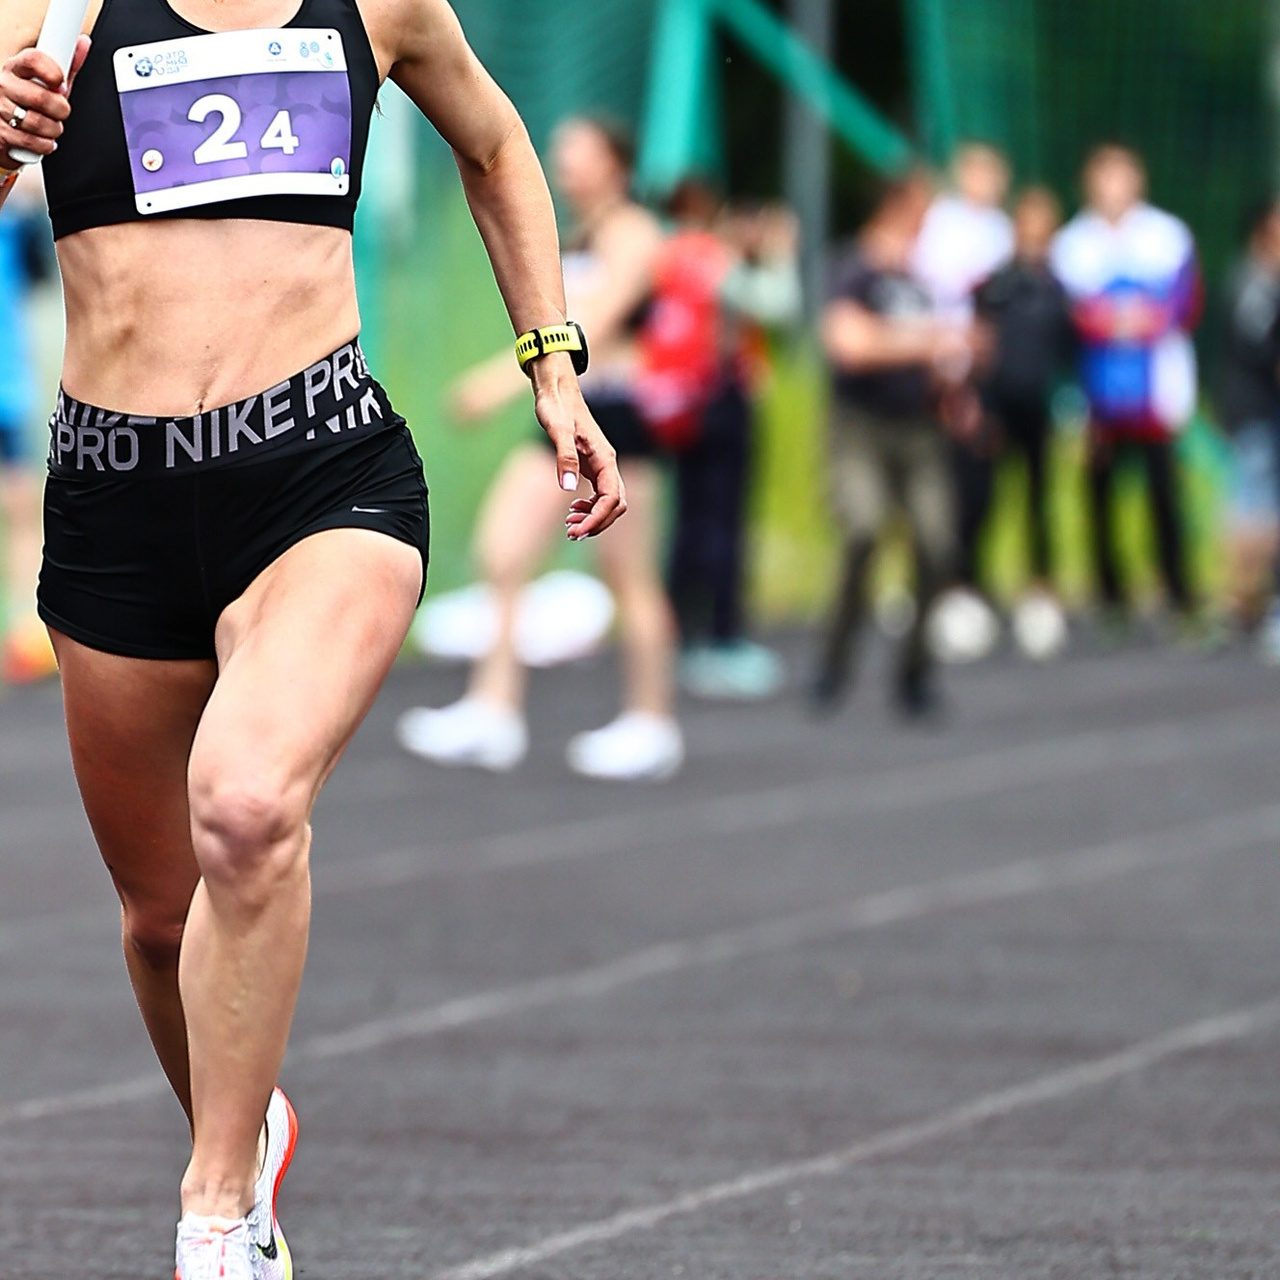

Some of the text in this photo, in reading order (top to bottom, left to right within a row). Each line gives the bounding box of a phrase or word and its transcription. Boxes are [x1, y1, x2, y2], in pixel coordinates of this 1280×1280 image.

[187, 93, 300, 165] 2 4
[56, 422, 140, 471] PRO
[165, 379, 296, 468] NIKE
